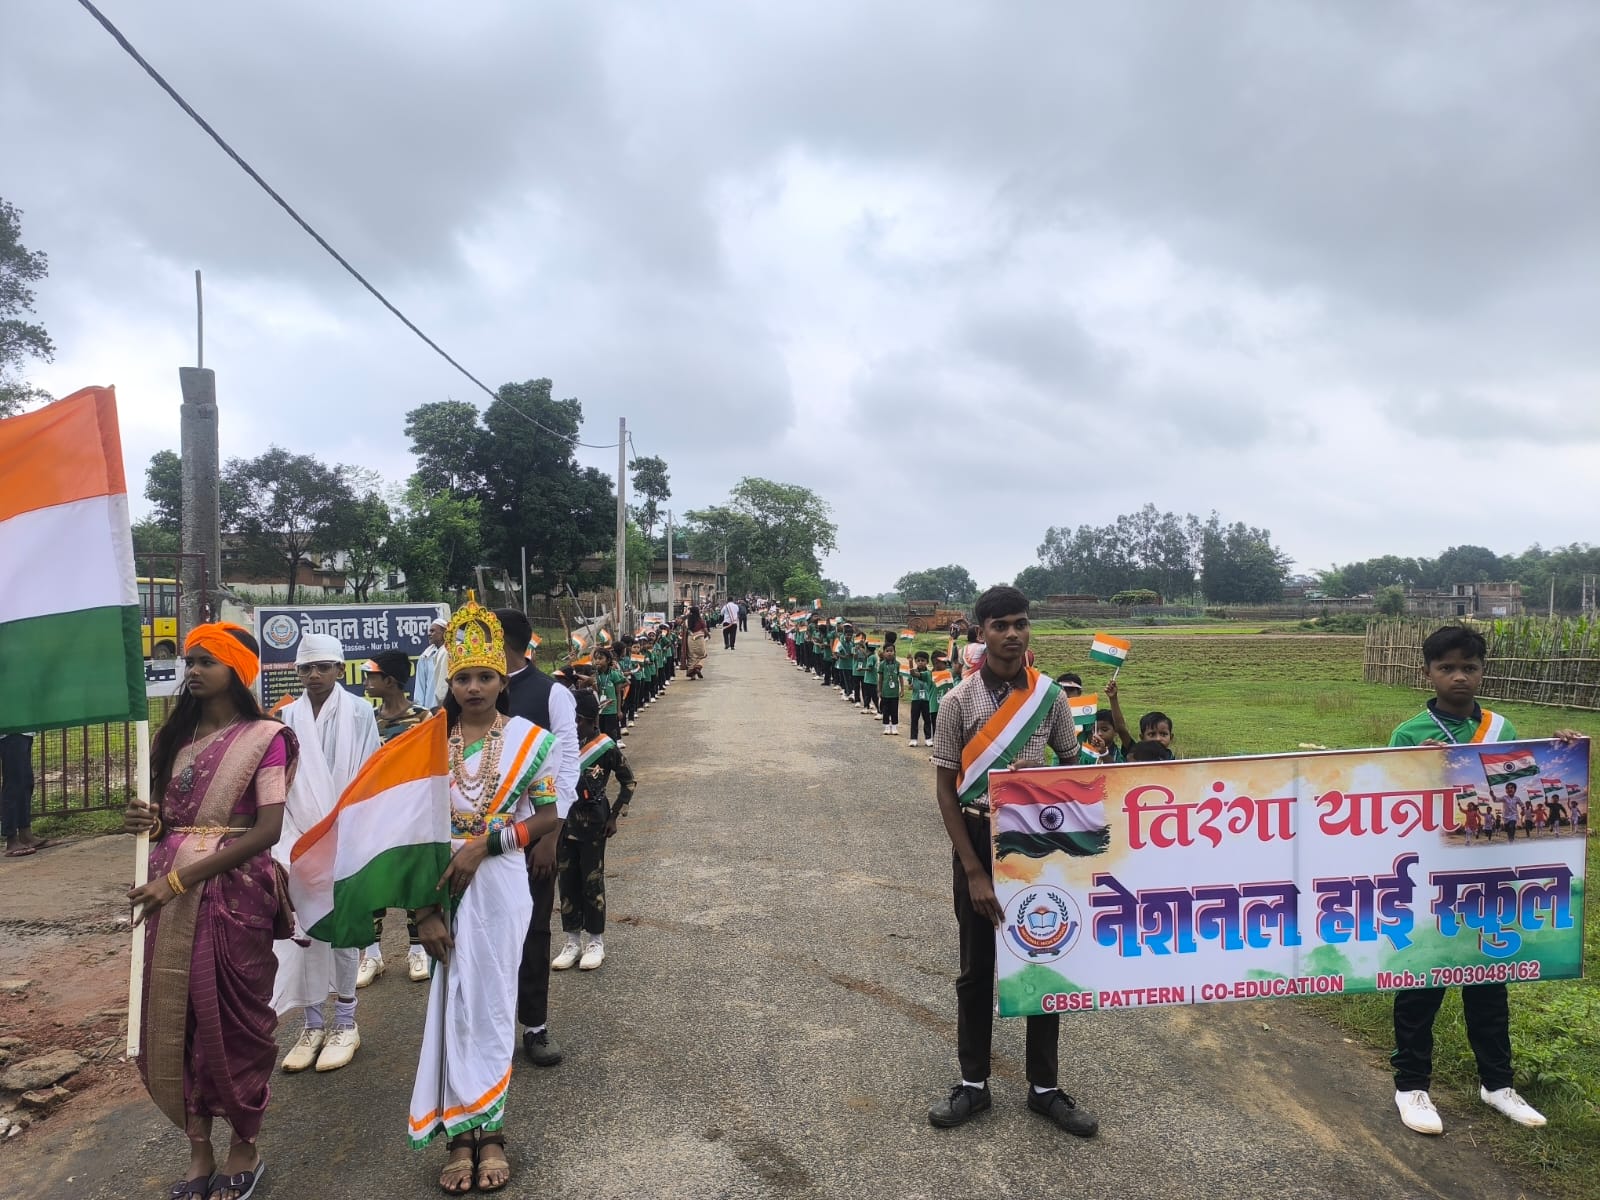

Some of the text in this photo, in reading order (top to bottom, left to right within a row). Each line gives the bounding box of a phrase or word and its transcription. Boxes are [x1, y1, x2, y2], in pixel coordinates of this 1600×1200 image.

[361, 610, 389, 641] हाई
[371, 642, 382, 651] Nur
[383, 642, 390, 650] to
[391, 641, 399, 649] IX
[1122, 781, 1464, 849] तिरंगा यात्रा
[1088, 852, 1574, 958] नेशनल हाई स्कुल
[1376, 960, 1540, 990] Mob.: 7903048162
[1042, 991, 1093, 1012] CBSE
[1099, 986, 1185, 1008] PATTERN
[1201, 975, 1344, 1001] CO-EDUCATION
